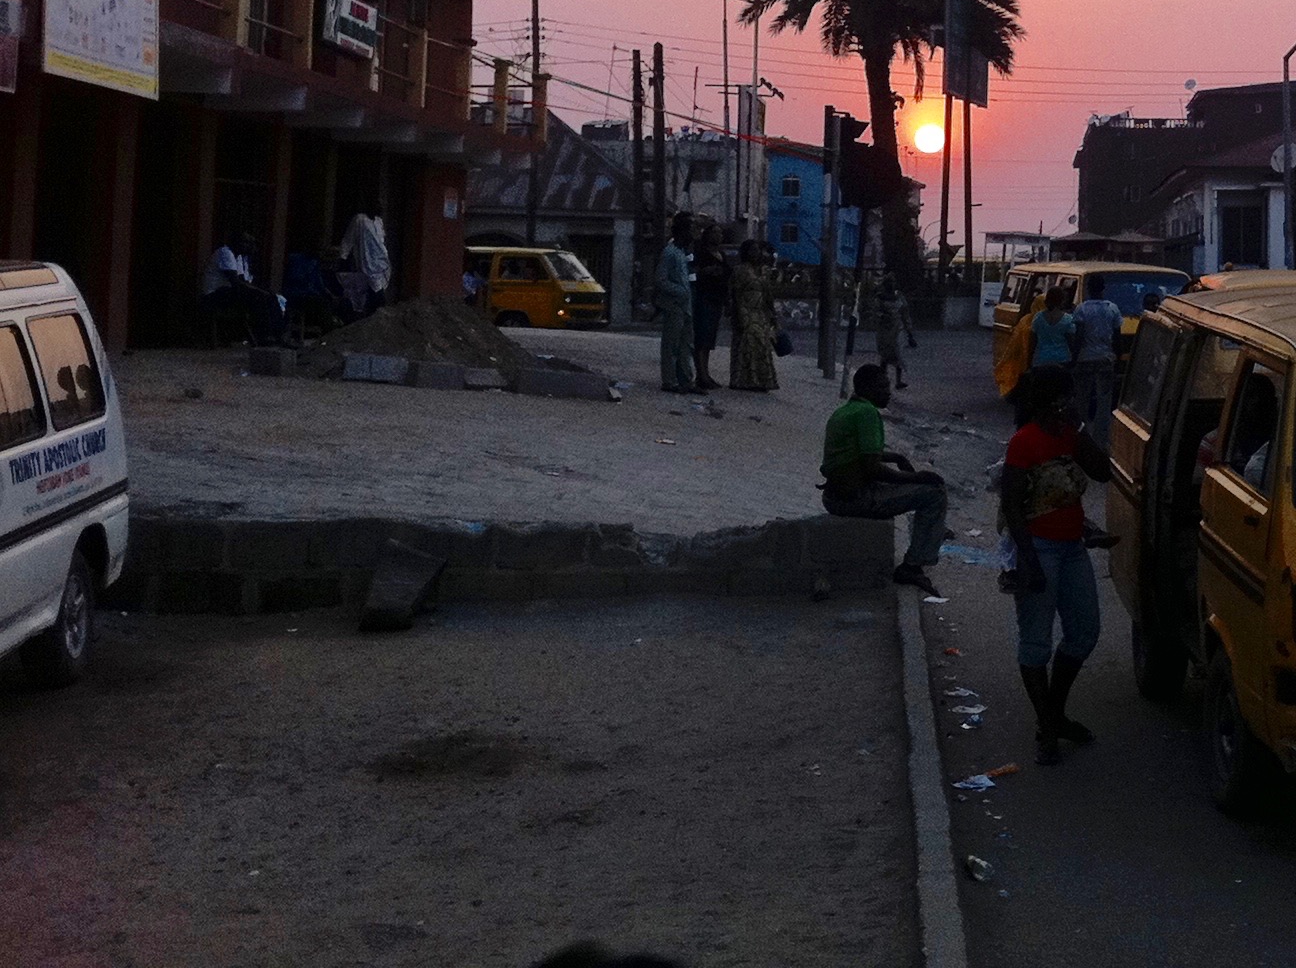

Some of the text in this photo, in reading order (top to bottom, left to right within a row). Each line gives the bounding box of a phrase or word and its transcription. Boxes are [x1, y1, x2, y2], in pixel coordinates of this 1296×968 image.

[9, 451, 42, 485] TRINITY
[43, 436, 82, 473] APOSTOLIC
[81, 427, 106, 458] CHURCH
